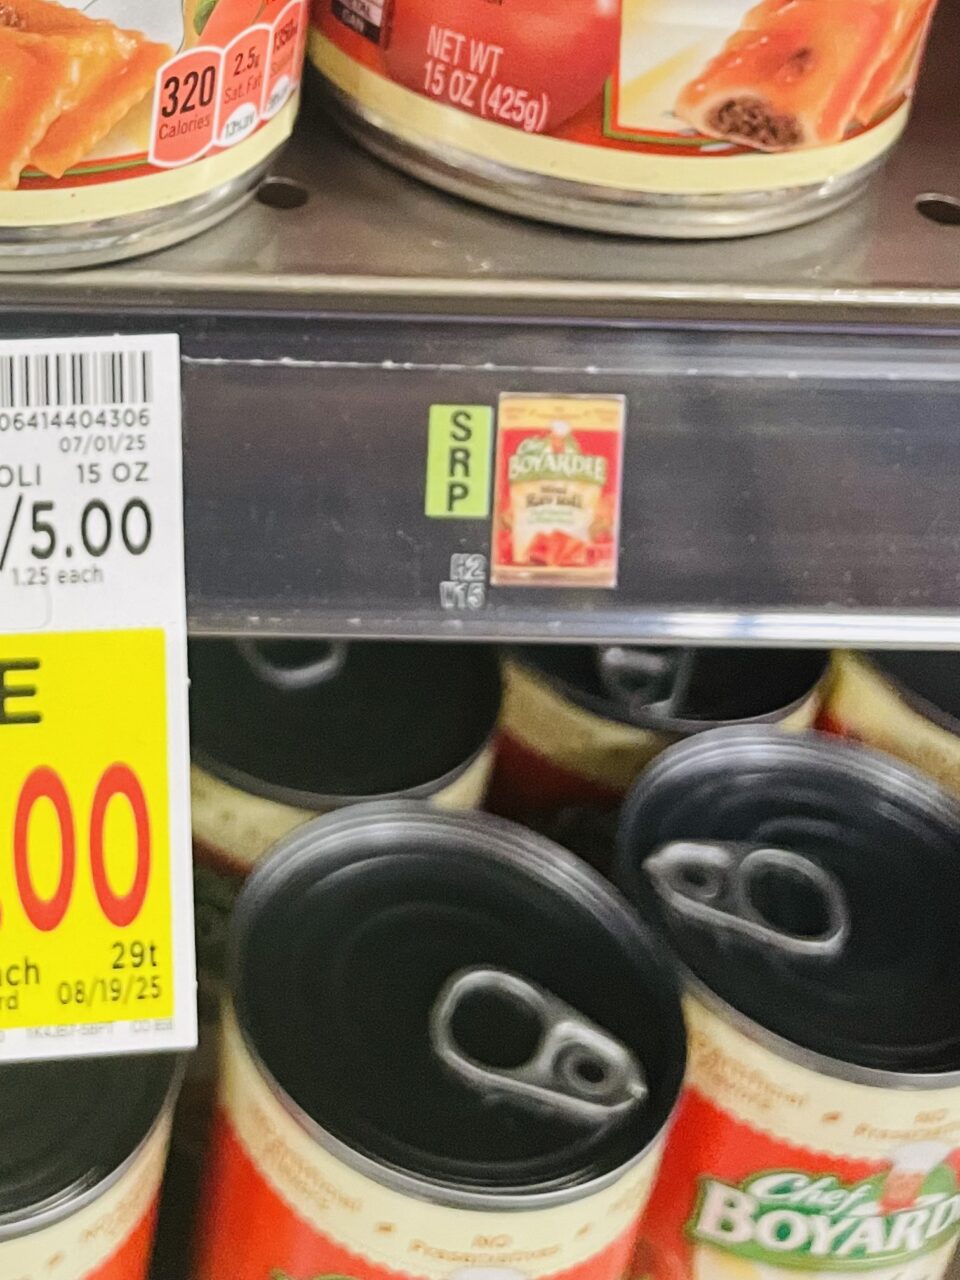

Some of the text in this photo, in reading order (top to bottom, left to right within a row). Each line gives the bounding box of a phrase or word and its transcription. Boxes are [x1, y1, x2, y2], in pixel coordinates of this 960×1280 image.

[427, 24, 504, 78] NET WT
[161, 65, 216, 118] 320
[424, 60, 548, 132] 15 OZ (425g)
[158, 114, 211, 140] Calories
[59, 433, 147, 456] 07/01/25
[76, 463, 100, 485] 15
[114, 461, 151, 484] OZ
[11, 564, 104, 586] 1.25 each
[111, 941, 159, 969] 29t
[58, 974, 162, 1007] 08/19/25
[748, 1172, 872, 1216] Chef
